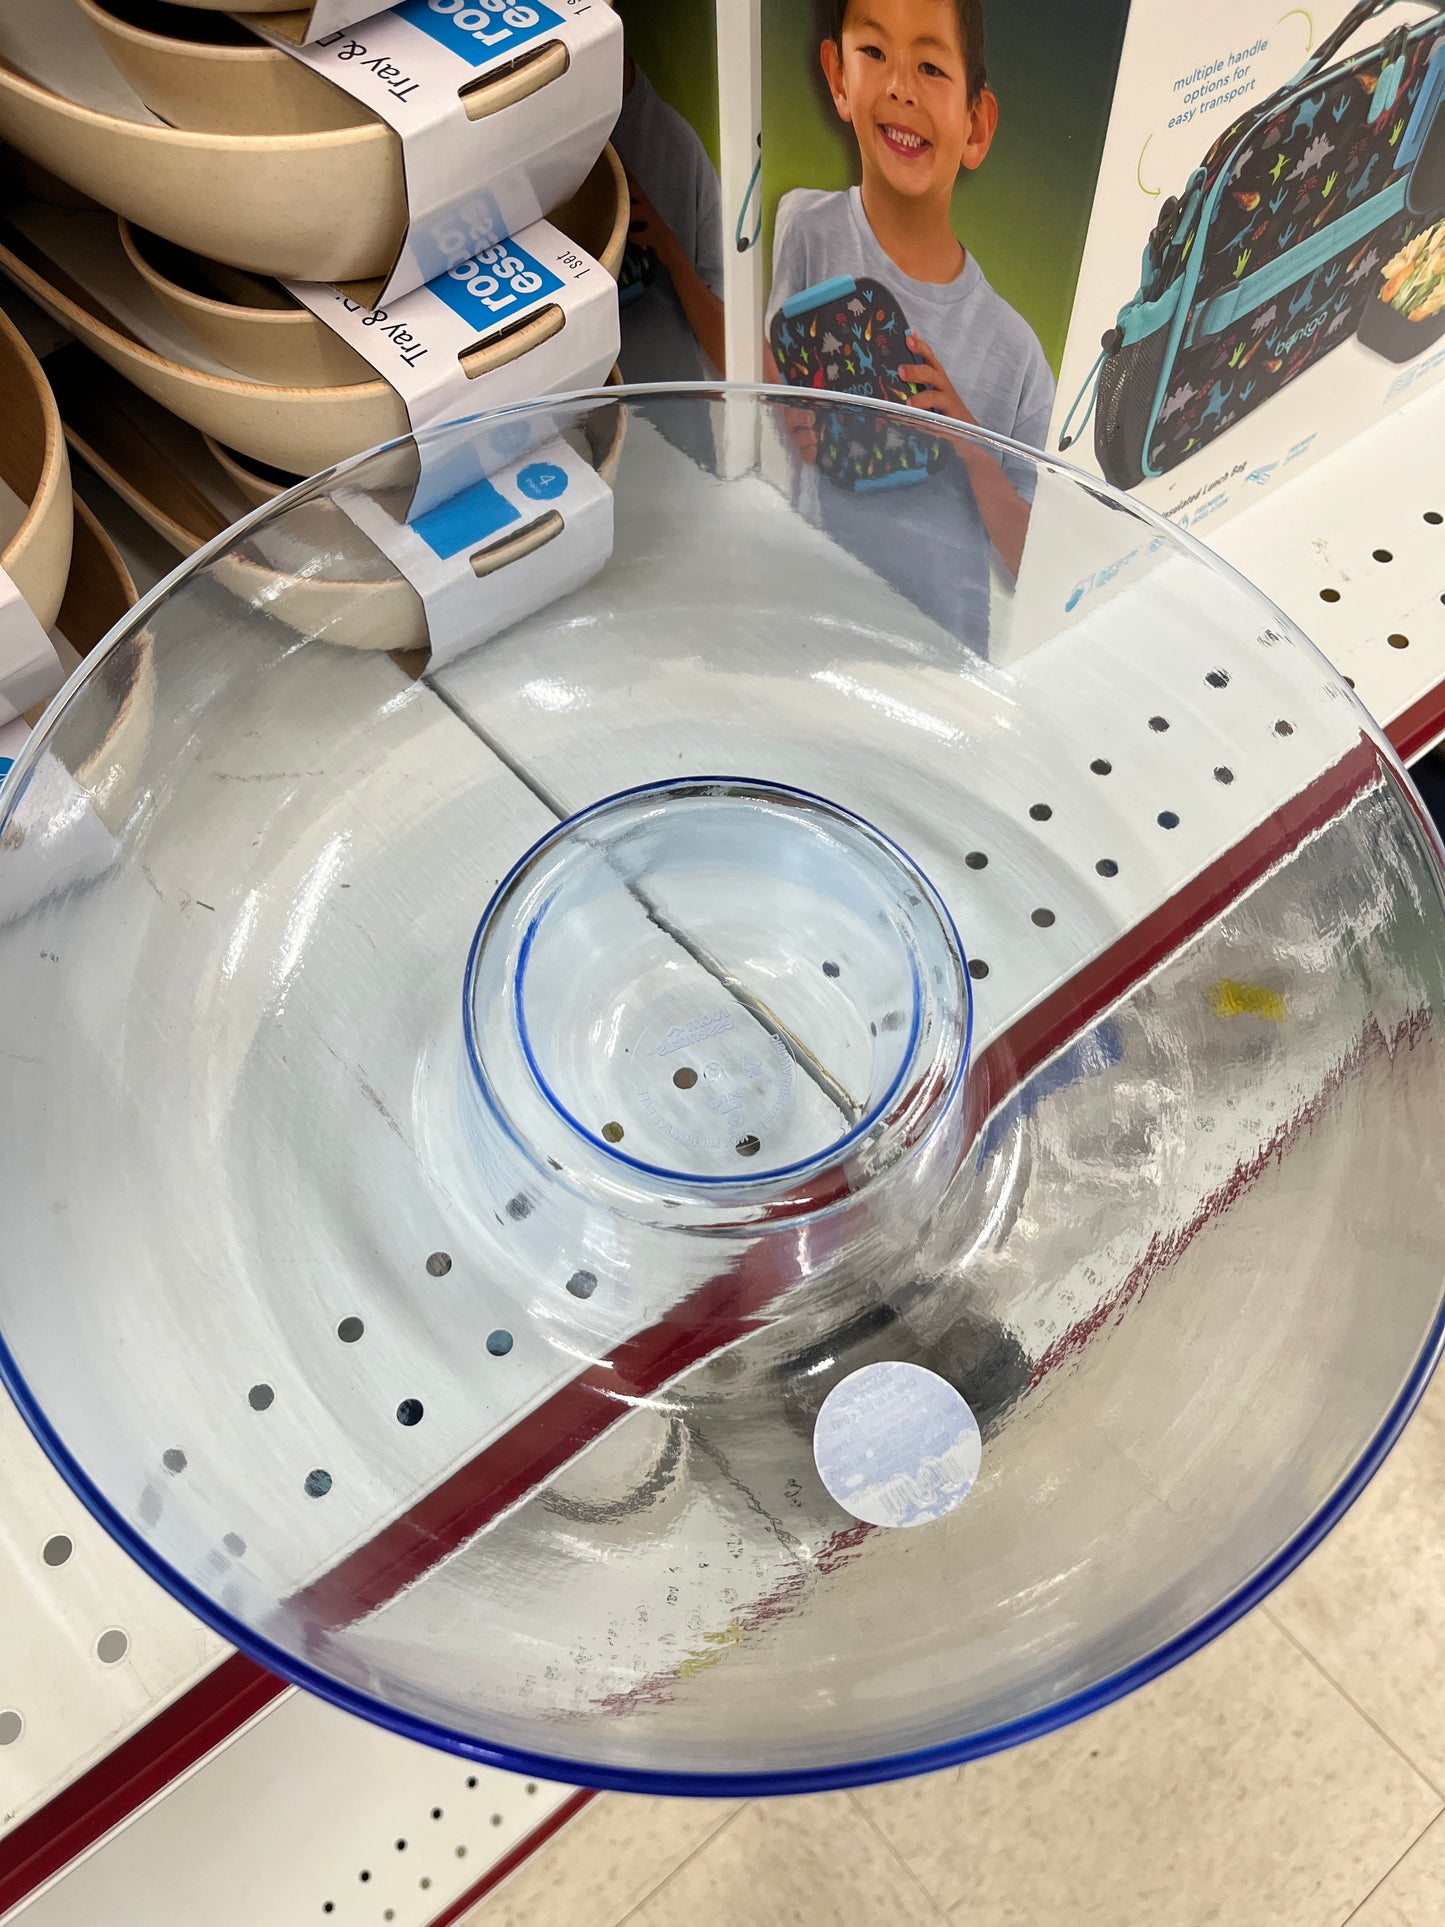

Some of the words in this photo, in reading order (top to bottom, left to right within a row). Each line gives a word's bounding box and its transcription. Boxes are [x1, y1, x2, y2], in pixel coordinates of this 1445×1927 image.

[337, 40, 368, 61] &
[1172, 58, 1225, 92] multiple
[1227, 39, 1269, 68] handle
[360, 56, 420, 104] Tray
[1183, 75, 1230, 104] options
[1232, 65, 1251, 82] for
[1167, 106, 1198, 129] easy
[1199, 78, 1256, 114] transport
[555, 250, 583, 271] set
[361, 308, 389, 327] &
[379, 322, 429, 369] Tray
